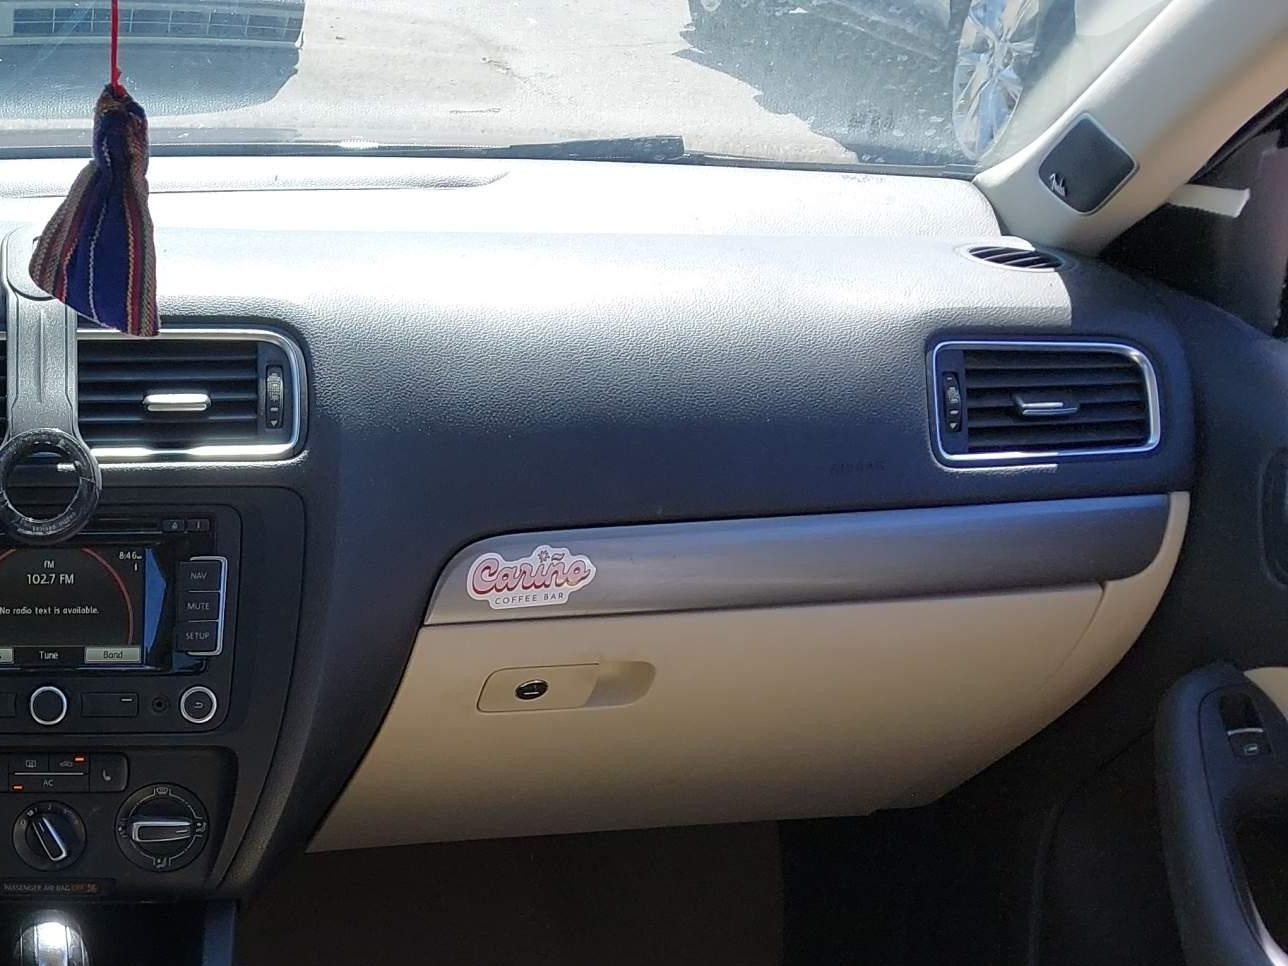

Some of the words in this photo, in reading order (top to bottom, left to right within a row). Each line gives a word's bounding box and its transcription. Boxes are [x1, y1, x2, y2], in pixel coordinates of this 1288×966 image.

[190, 571, 207, 580] NAV
[473, 552, 592, 595] Cariño
[26, 574, 56, 585] 102.7
[59, 574, 74, 585] FM
[494, 594, 538, 605] COFFEE
[543, 592, 564, 601] BAR
[0, 606, 11, 615] No
[12, 606, 32, 615] radio
[34, 607, 51, 615] text
[53, 606, 60, 615] is
[187, 602, 210, 610] MUTE
[185, 632, 210, 640] SETUP
[39, 650, 59, 660] Tune
[103, 650, 124, 659] Band
